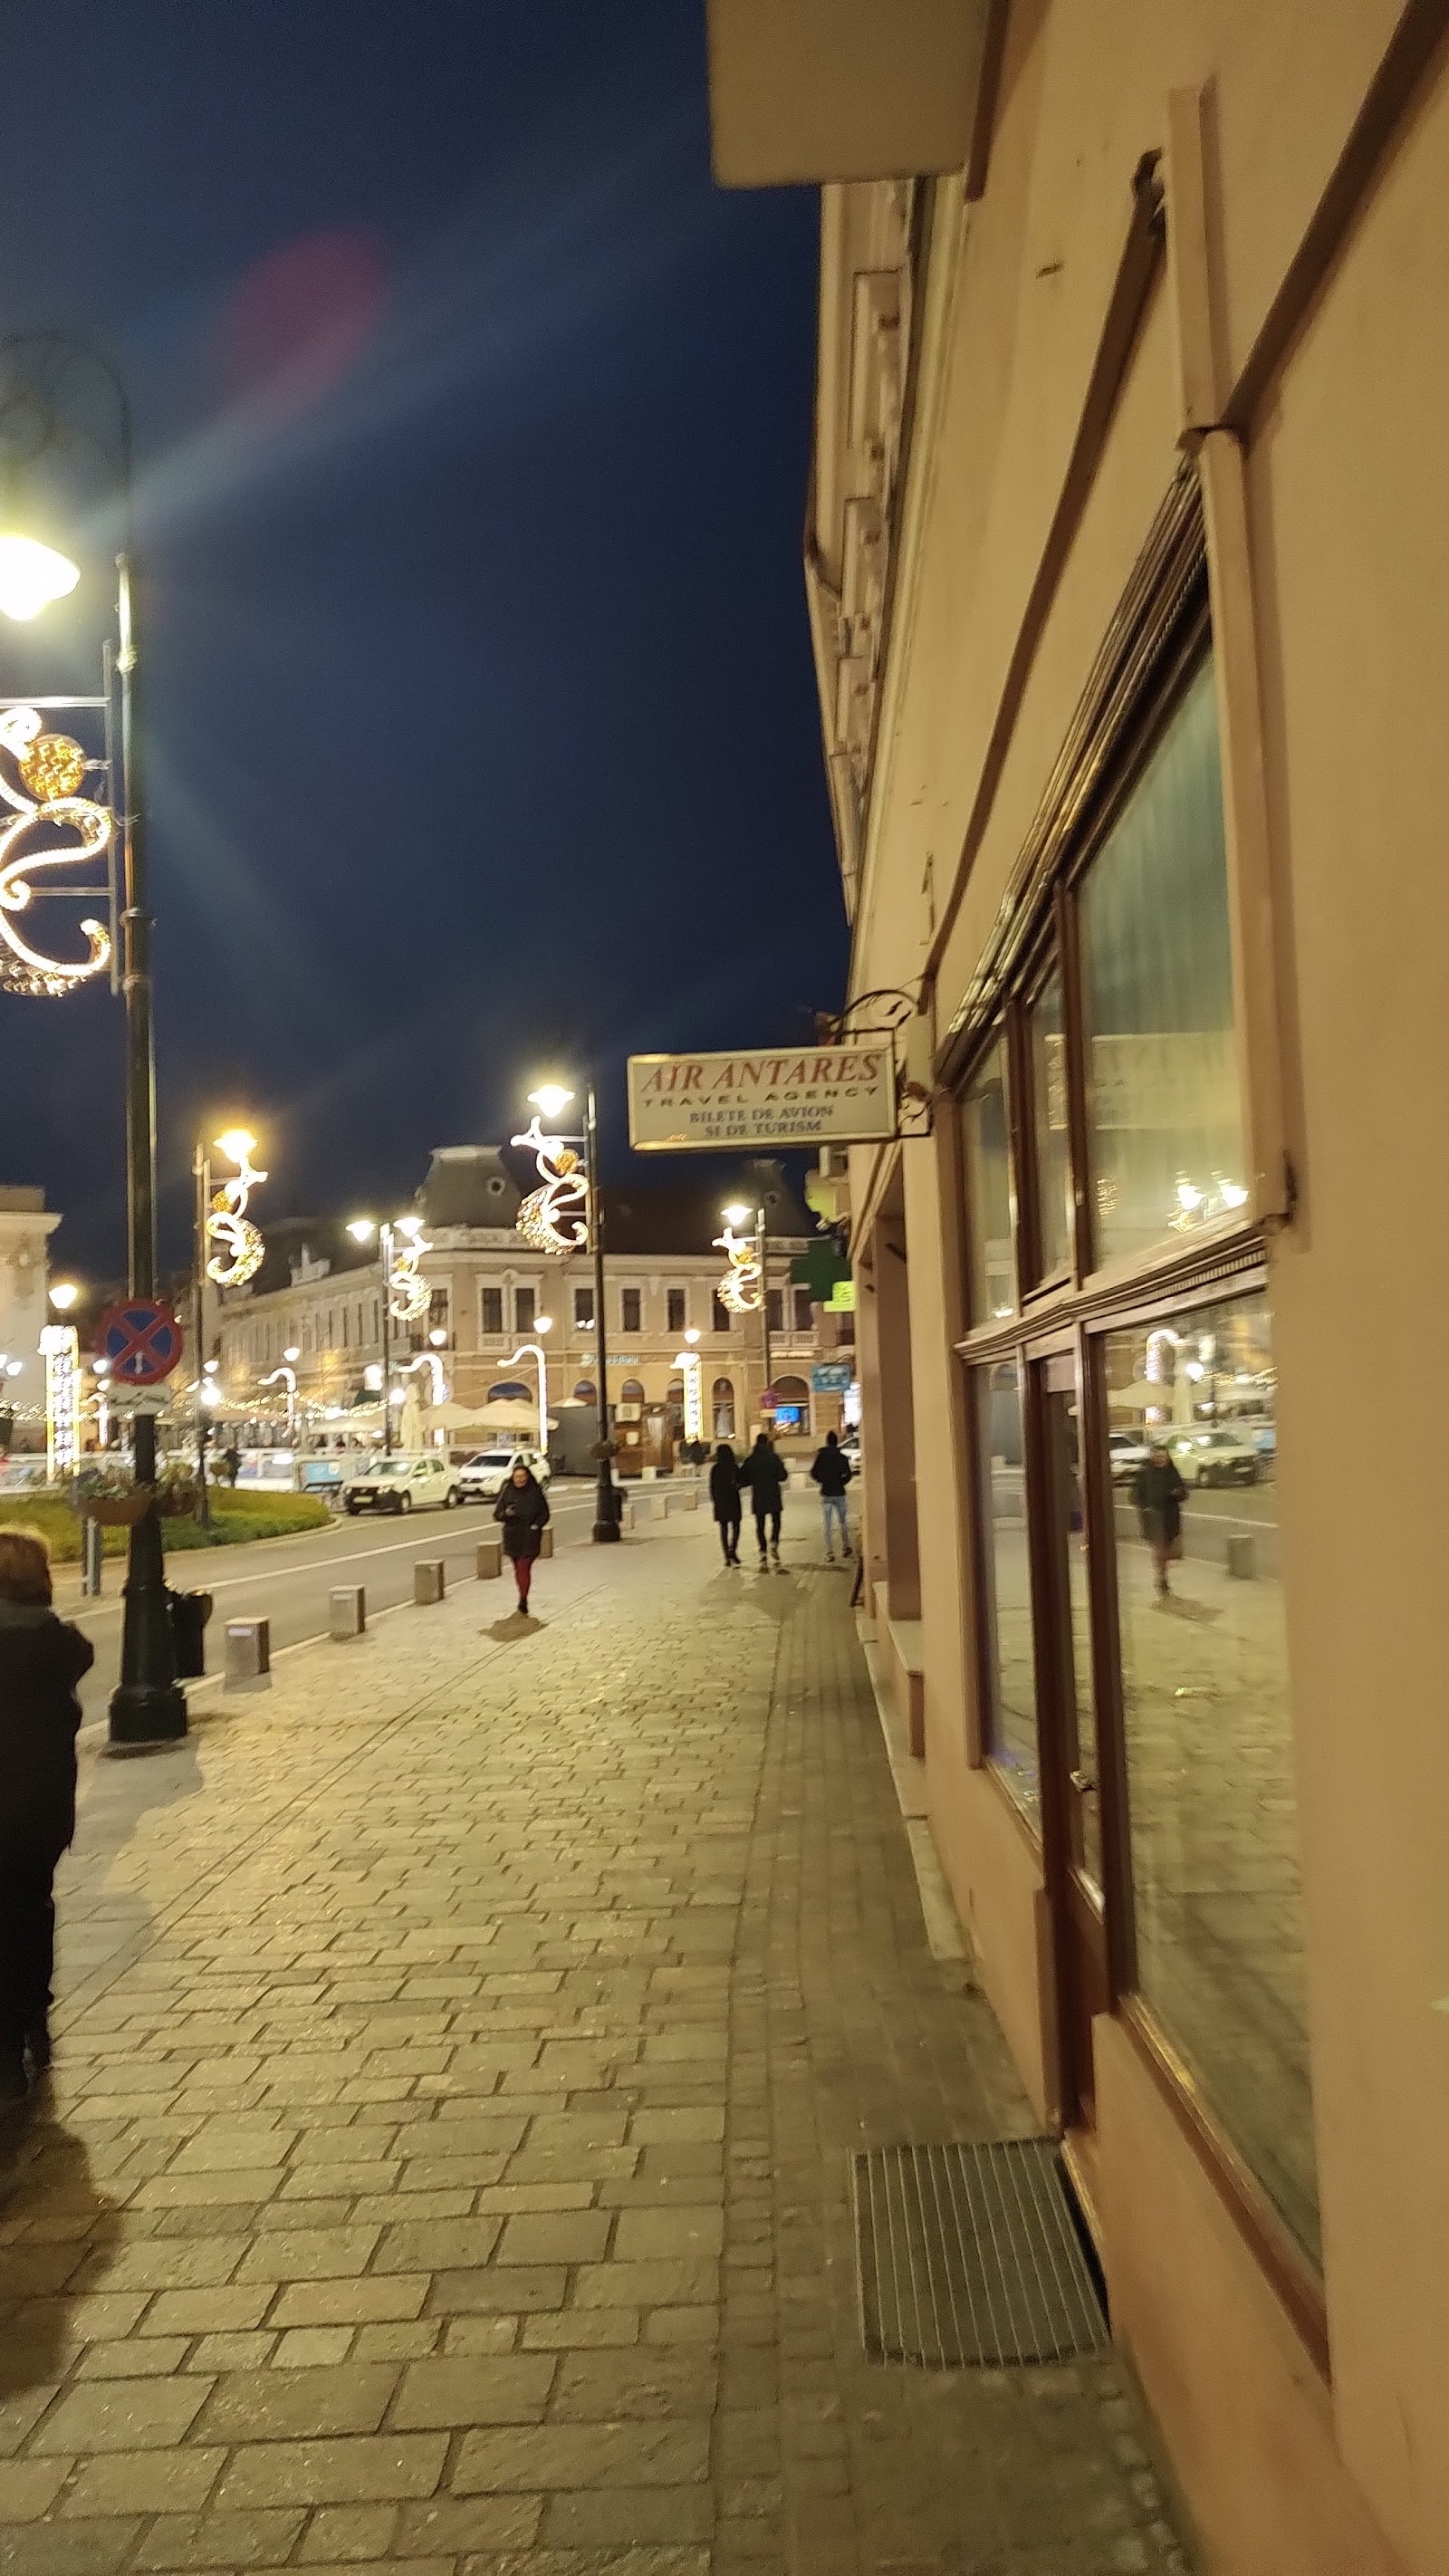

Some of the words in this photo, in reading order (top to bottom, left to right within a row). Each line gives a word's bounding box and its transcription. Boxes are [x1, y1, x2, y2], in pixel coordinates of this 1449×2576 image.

[641, 1063, 703, 1092] AIR
[711, 1053, 882, 1090] ANTARES
[644, 1093, 748, 1108] TRAVEL
[764, 1086, 878, 1101] AGENCY
[689, 1110, 745, 1123] BILETE
[753, 1107, 773, 1120] DE
[779, 1104, 834, 1119] AVION
[725, 1123, 747, 1136] DE
[754, 1120, 822, 1135] TURISM
